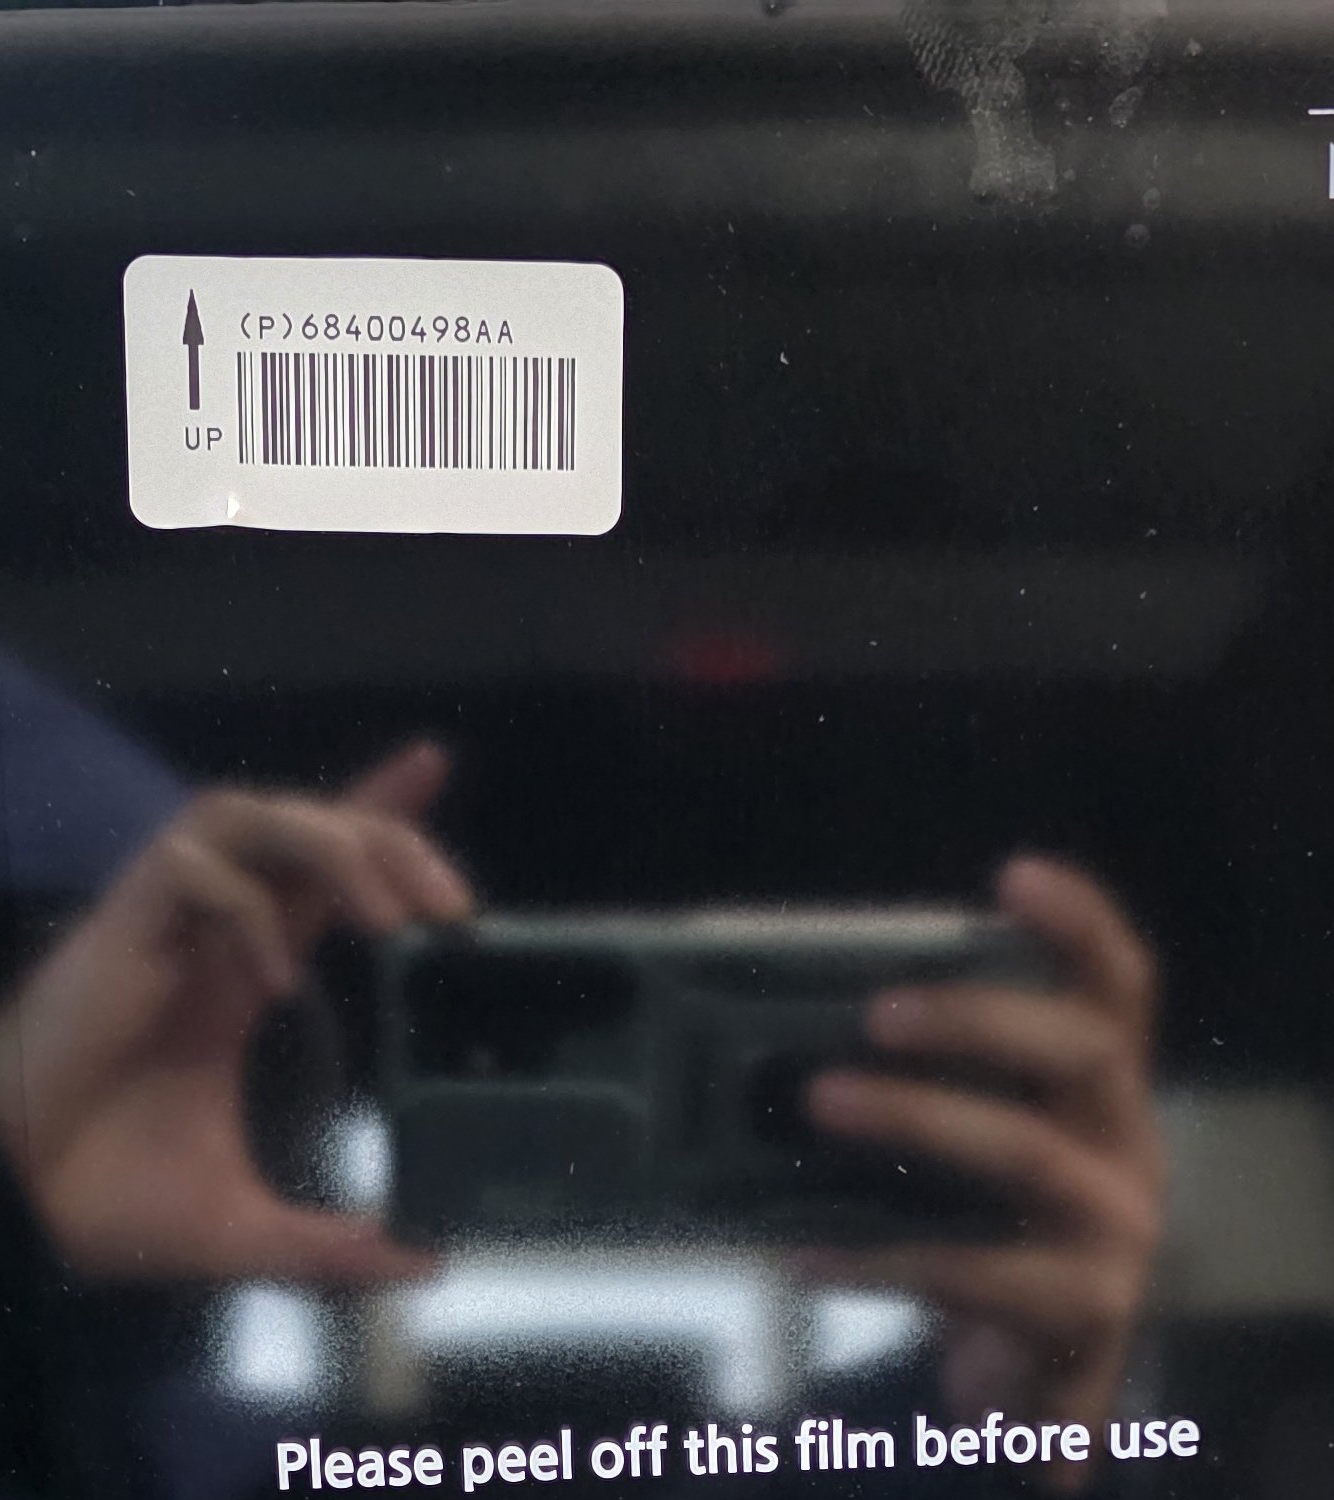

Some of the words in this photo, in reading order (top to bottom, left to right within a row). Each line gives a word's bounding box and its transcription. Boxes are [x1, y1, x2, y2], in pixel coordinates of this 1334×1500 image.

[240, 312, 514, 344] (P)68400498AA
[185, 426, 223, 451] UP
[276, 1438, 444, 1491] Please
[462, 1428, 573, 1493] peel
[591, 1424, 668, 1479] off
[683, 1423, 779, 1476] this
[794, 1418, 895, 1471] film
[916, 1411, 1091, 1467] before
[1110, 1419, 1200, 1460] use
